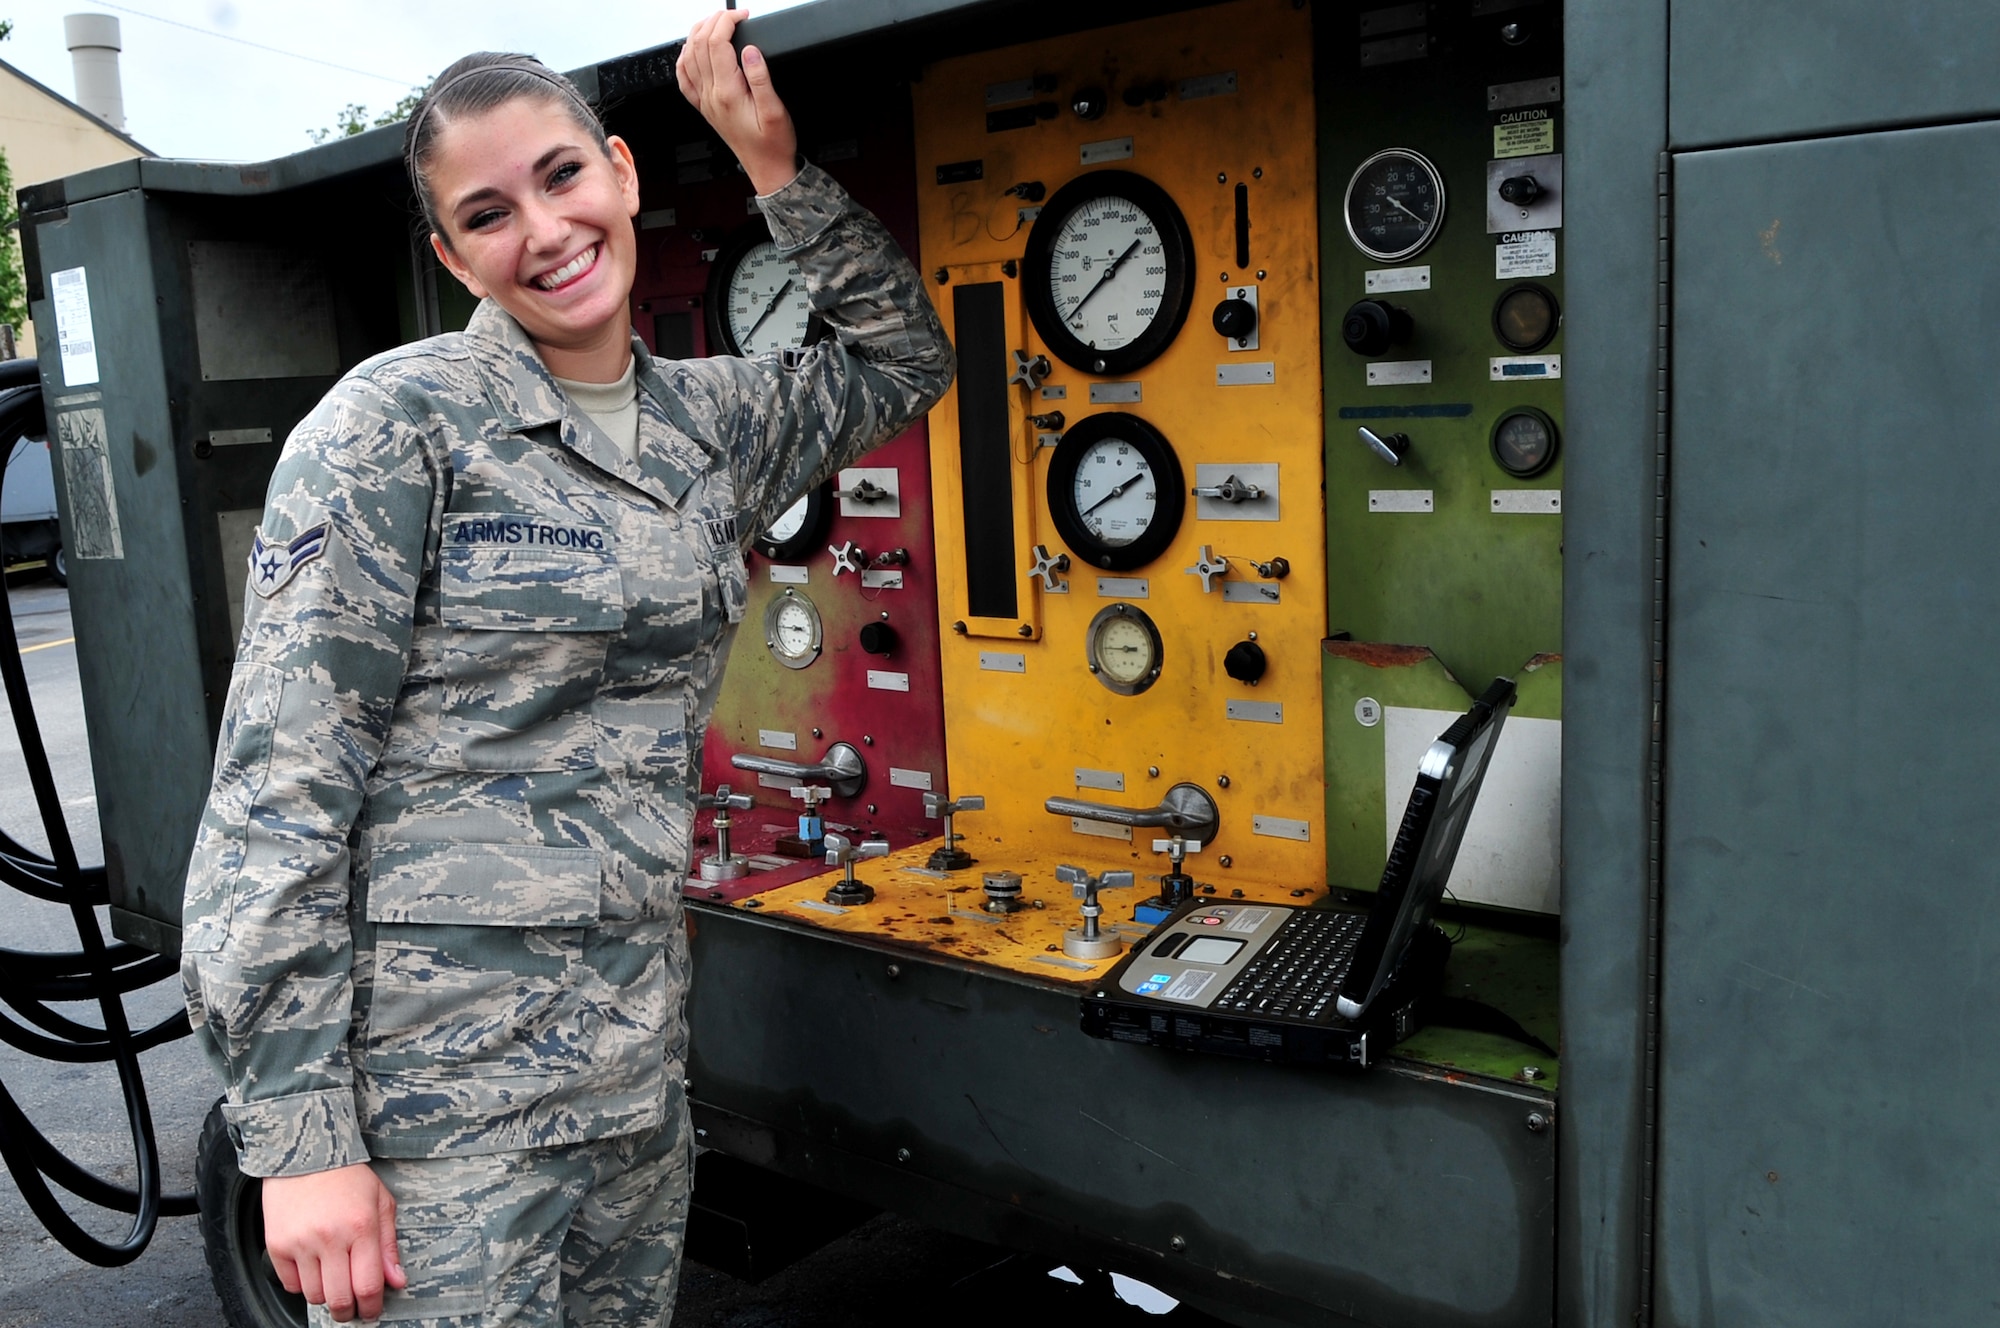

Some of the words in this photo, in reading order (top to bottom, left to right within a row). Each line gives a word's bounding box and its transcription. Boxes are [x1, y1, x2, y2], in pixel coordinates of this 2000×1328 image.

[1500, 109, 1548, 123] CAUTION
[1387, 172, 1398, 182] 20
[1406, 172, 1416, 182] 15
[1375, 186, 1386, 196] 25
[1417, 185, 1428, 194] 10
[1369, 204, 1380, 214] 30
[1423, 202, 1430, 211] 5
[1102, 210, 1120, 220] 3000
[1120, 213, 1138, 223] 3500
[1083, 218, 1100, 227] 2500
[1418, 222, 1424, 230] 0
[1134, 226, 1152, 236] 4000
[1375, 226, 1386, 235] 35
[1070, 233, 1088, 242] 2000
[1502, 231, 1550, 244] CAUTION
[1064, 250, 1080, 259] 1500
[1142, 246, 1160, 255] 4500
[1146, 266, 1164, 276] 5000
[742, 272, 754, 280] 2000
[1062, 274, 1076, 282] 1000
[1144, 290, 1160, 298] 5500
[1067, 296, 1080, 304] 500
[1078, 312, 1082, 320] 0
[1136, 308, 1154, 316] 6000
[1108, 313, 1118, 322] psi
[1118, 447, 1128, 455] 150
[1096, 456, 1106, 464] 100
[1136, 462, 1148, 470] 200
[1136, 518, 1148, 526] 300
[454, 521, 604, 548] ARMSTRONG
